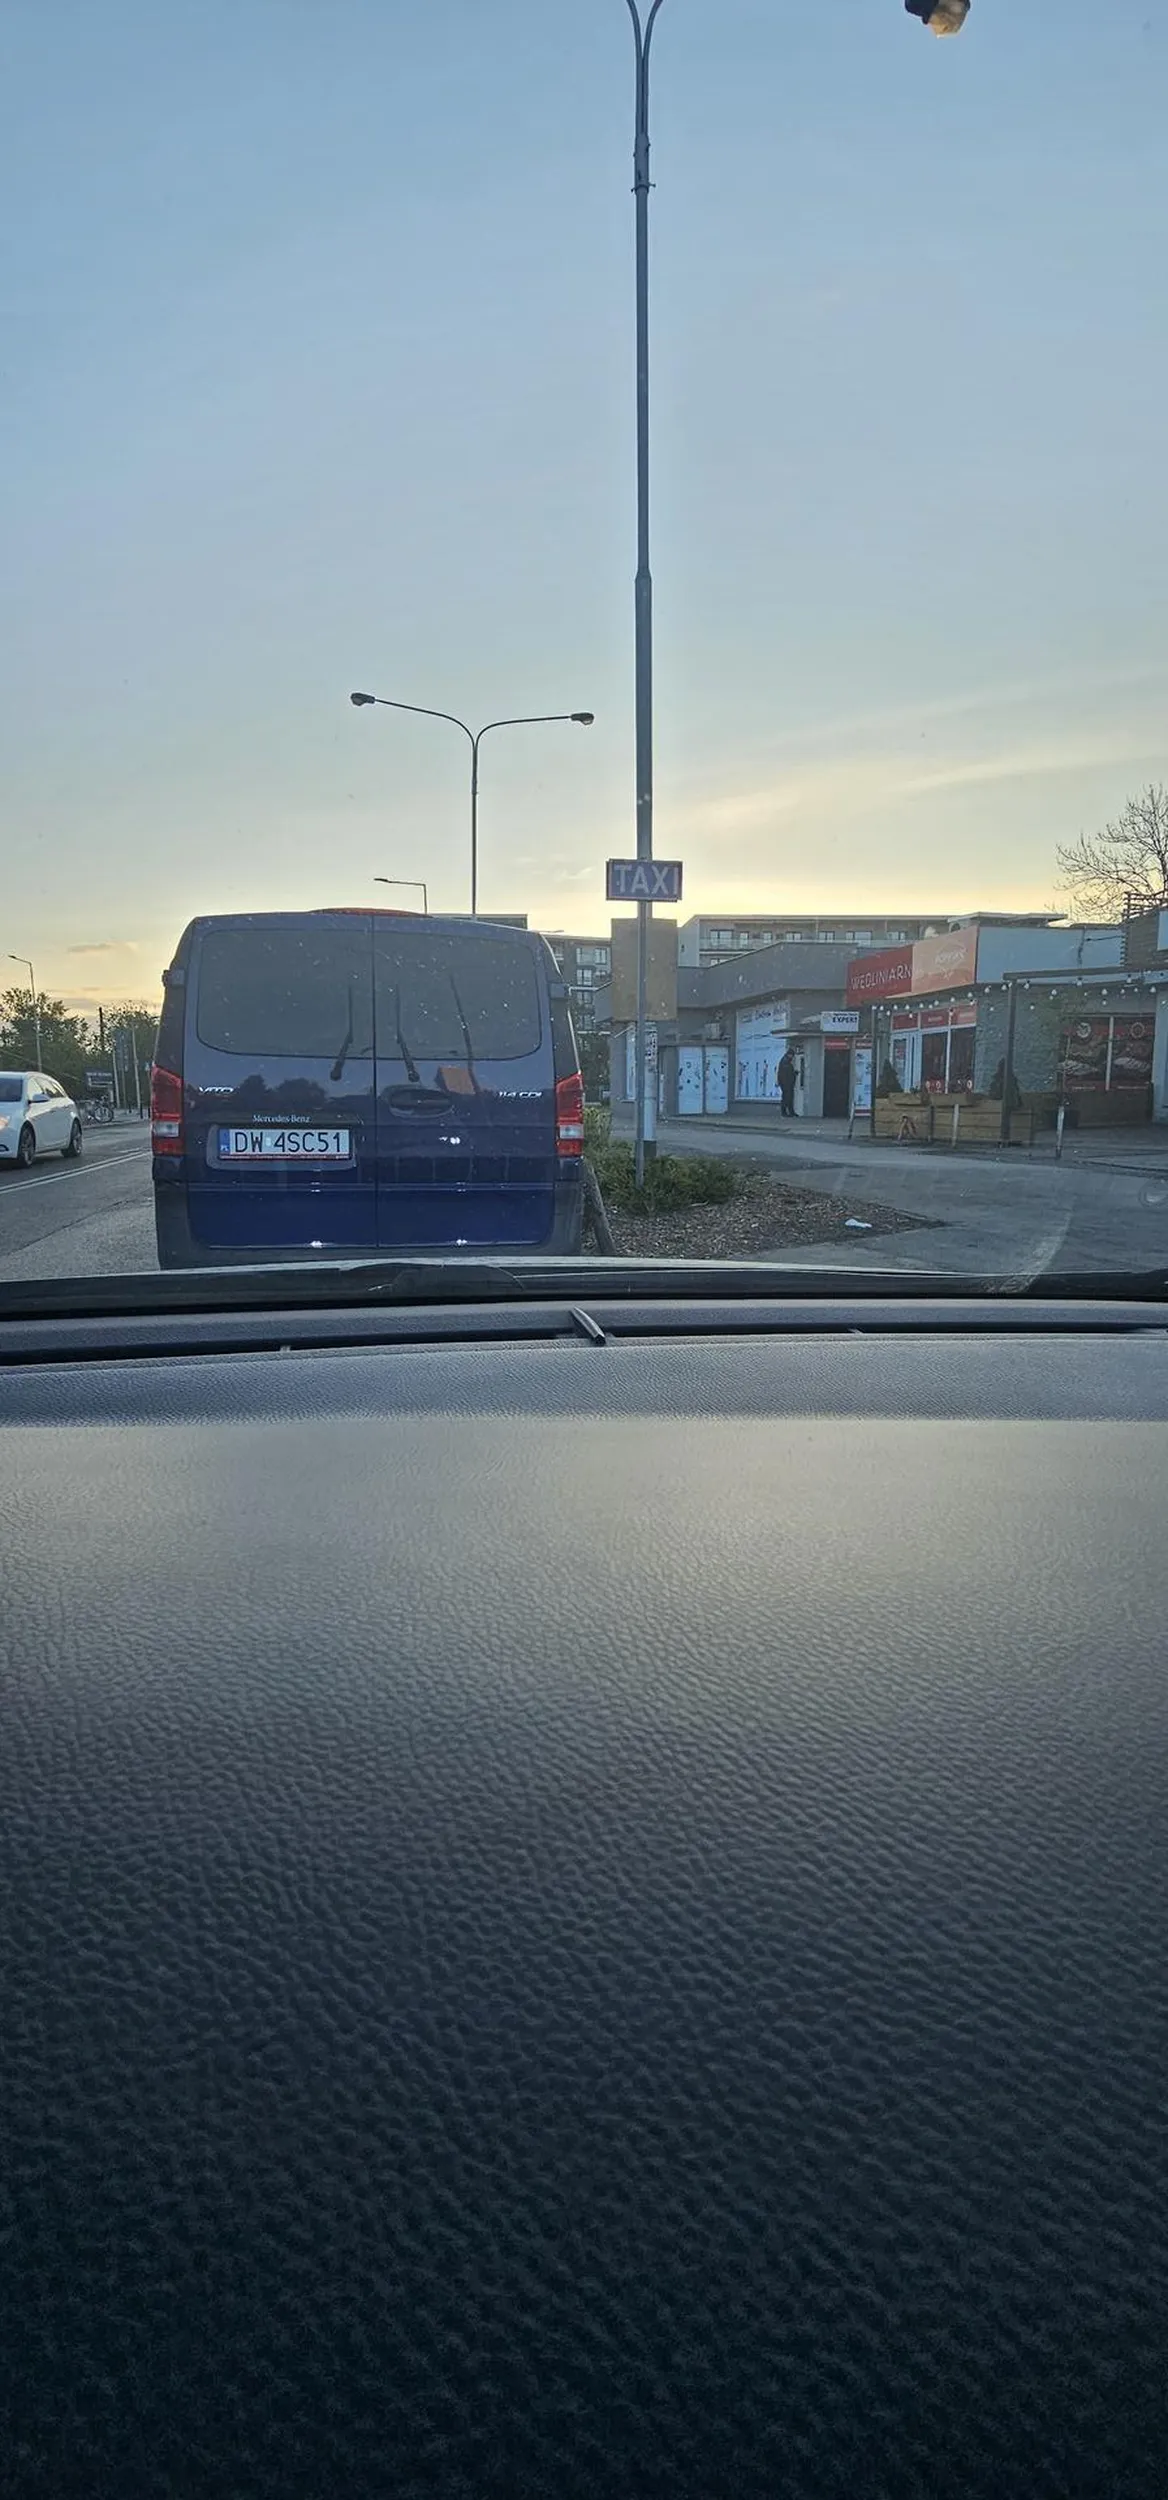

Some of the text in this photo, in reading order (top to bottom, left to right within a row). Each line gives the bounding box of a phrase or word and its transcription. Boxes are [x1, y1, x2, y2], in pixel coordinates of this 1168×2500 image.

[614, 864, 679, 895] TAXI
[199, 1086, 234, 1094] VITO
[519, 1091, 542, 1099] CDI
[252, 1114, 311, 1123] Mercedes-Benz
[235, 1132, 341, 1153] DW 4SC51
